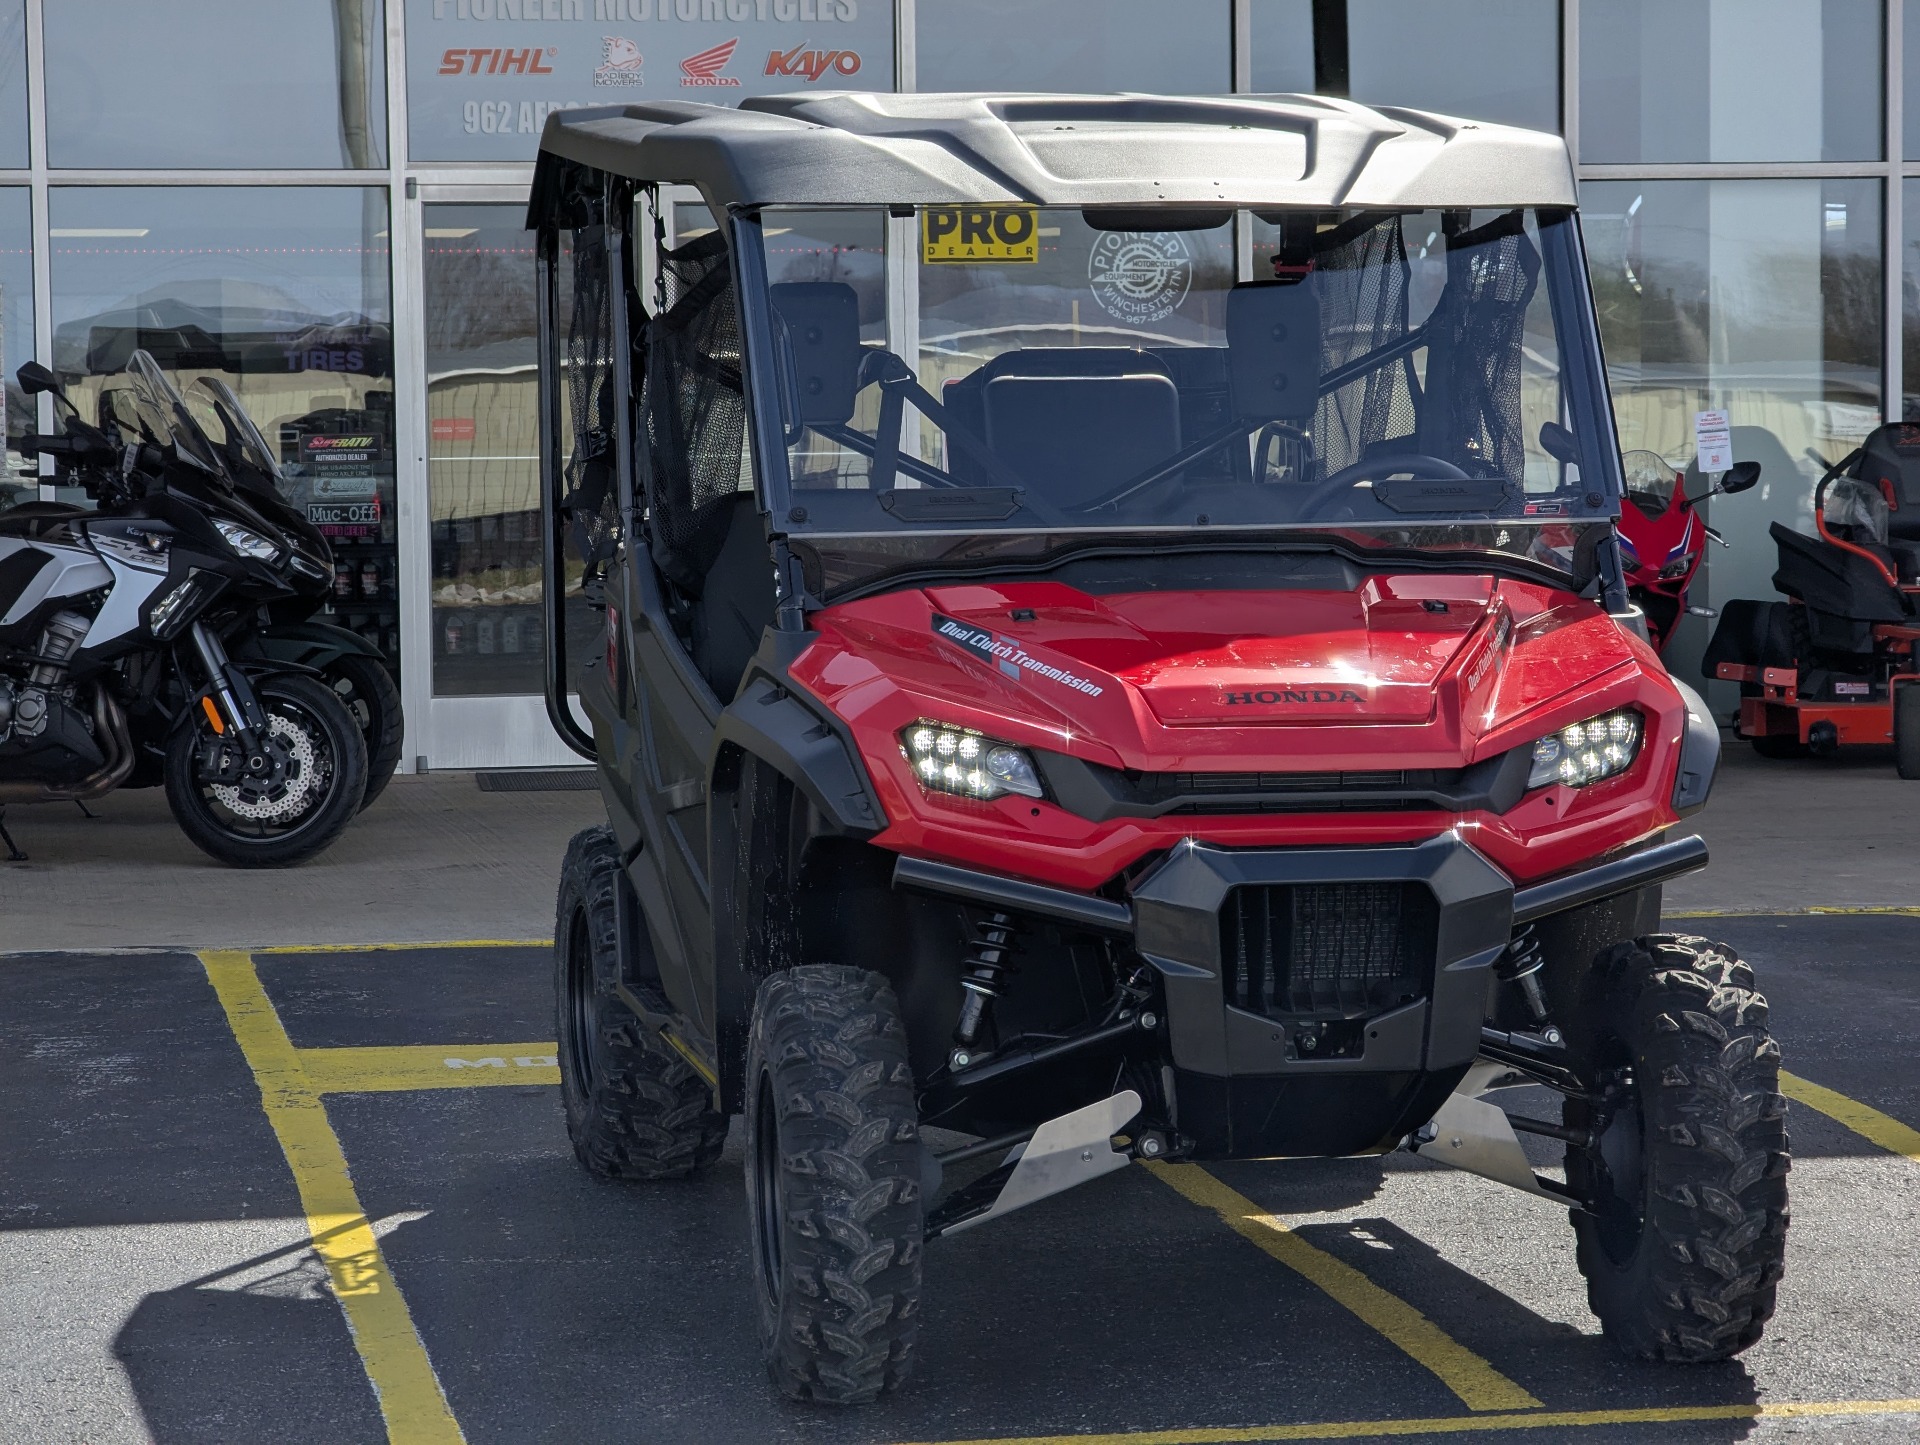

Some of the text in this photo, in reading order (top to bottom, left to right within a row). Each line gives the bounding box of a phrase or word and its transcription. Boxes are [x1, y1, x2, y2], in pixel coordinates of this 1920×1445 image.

[439, 48, 553, 75] STIHL
[764, 41, 862, 82] KAYO
[682, 78, 740, 86] HONDA
[464, 101, 512, 134] 962
[928, 204, 1033, 245] PRO
[928, 247, 1033, 256] DEALER
[1132, 260, 1177, 268] MOTORCYCLES
[1169, 270, 1182, 287] TN
[1108, 305, 1174, 324] 931-967-2219
[284, 350, 364, 371] TIRES
[347, 453, 368, 461] DEALER
[311, 506, 377, 522] Muc-Off
[322, 525, 367, 536] SOLD HERE
[939, 621, 1103, 698] Dual Clutch Transmission
[1224, 690, 1368, 706] HONDA
